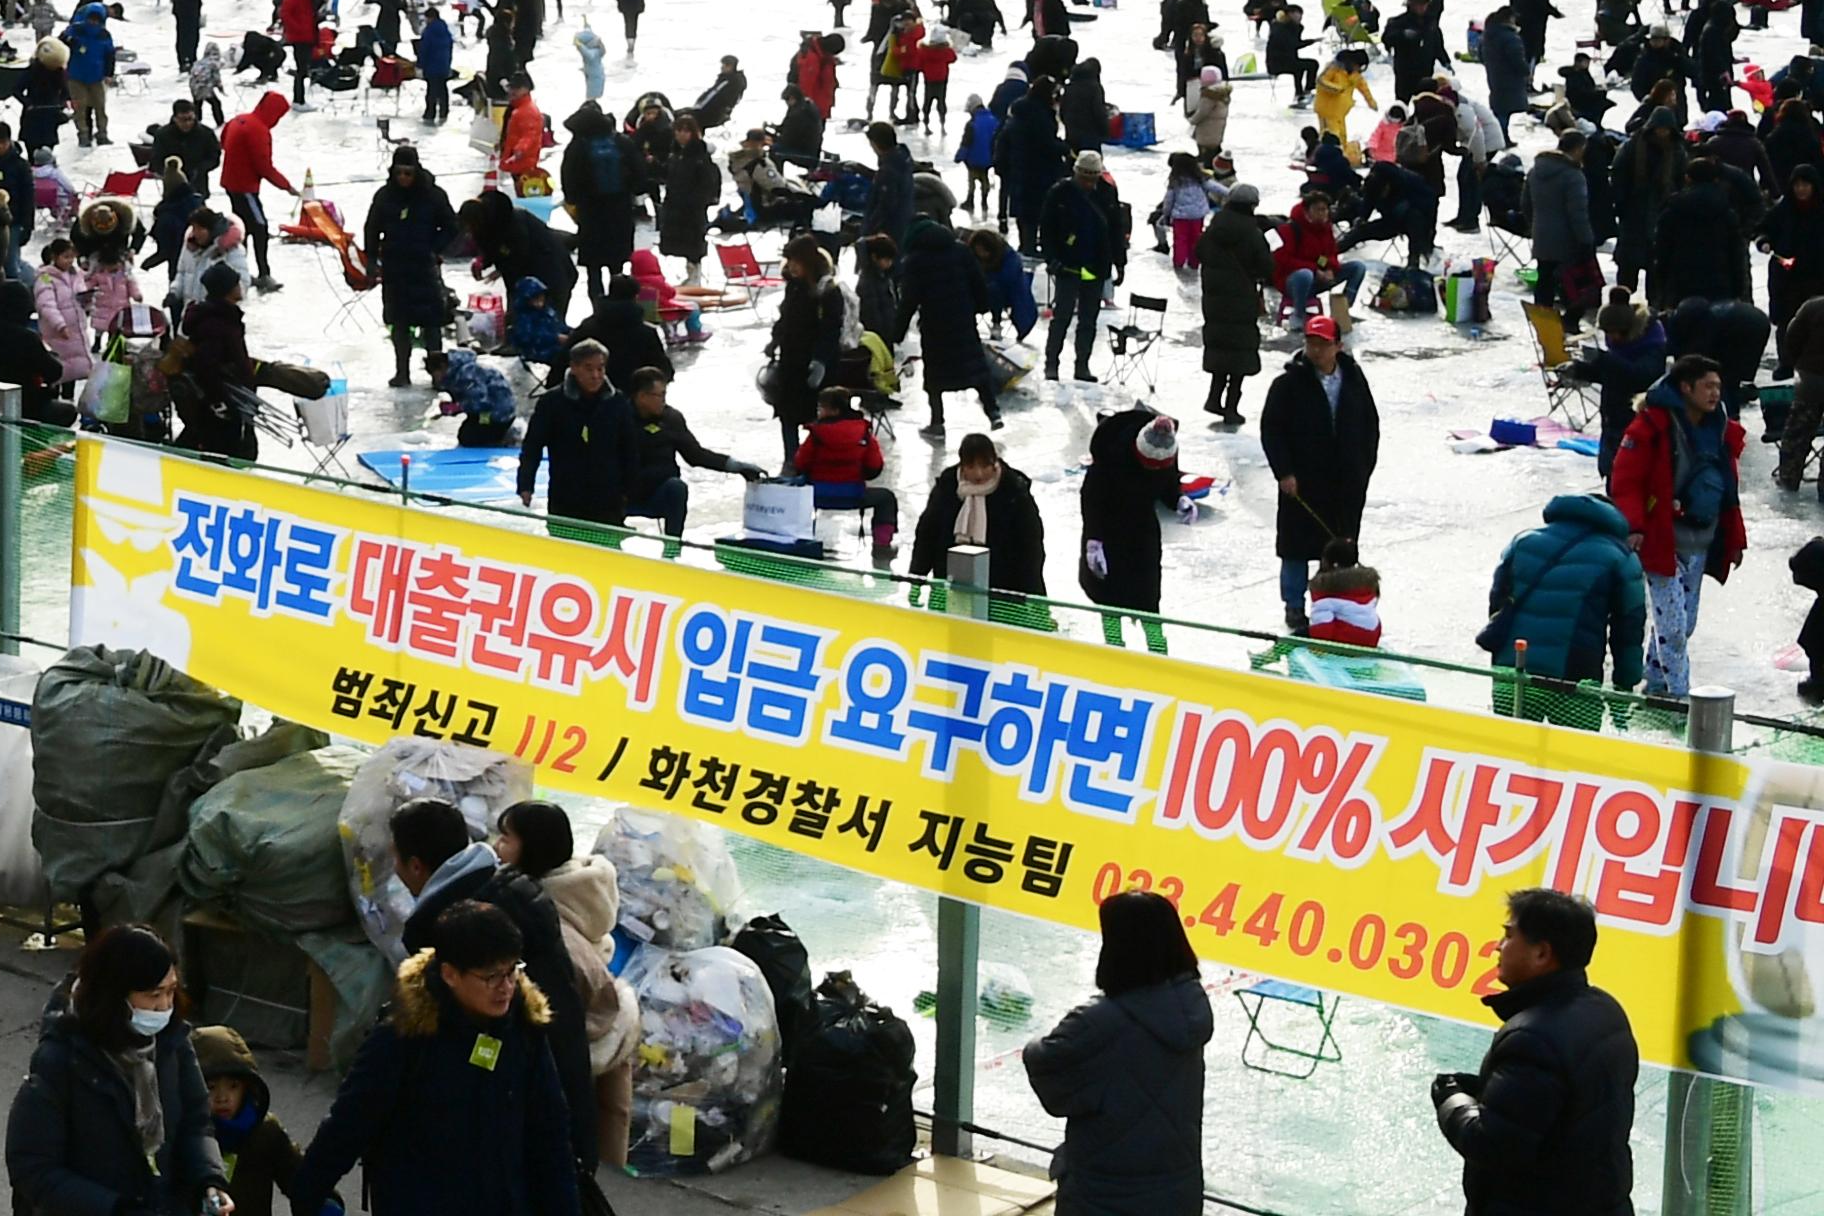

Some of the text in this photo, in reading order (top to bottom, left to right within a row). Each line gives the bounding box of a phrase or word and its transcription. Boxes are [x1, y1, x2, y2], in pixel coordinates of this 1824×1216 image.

[172, 496, 338, 619] 전화로
[349, 538, 667, 706] 대출권유시
[680, 610, 822, 737] 입금
[829, 646, 1154, 816] 요구하면
[1162, 710, 1376, 861] 100%
[330, 666, 500, 749] 범죄신고
[513, 714, 589, 774] 112
[639, 744, 890, 856] 화천경찰서
[907, 806, 1076, 901] 지능팀
